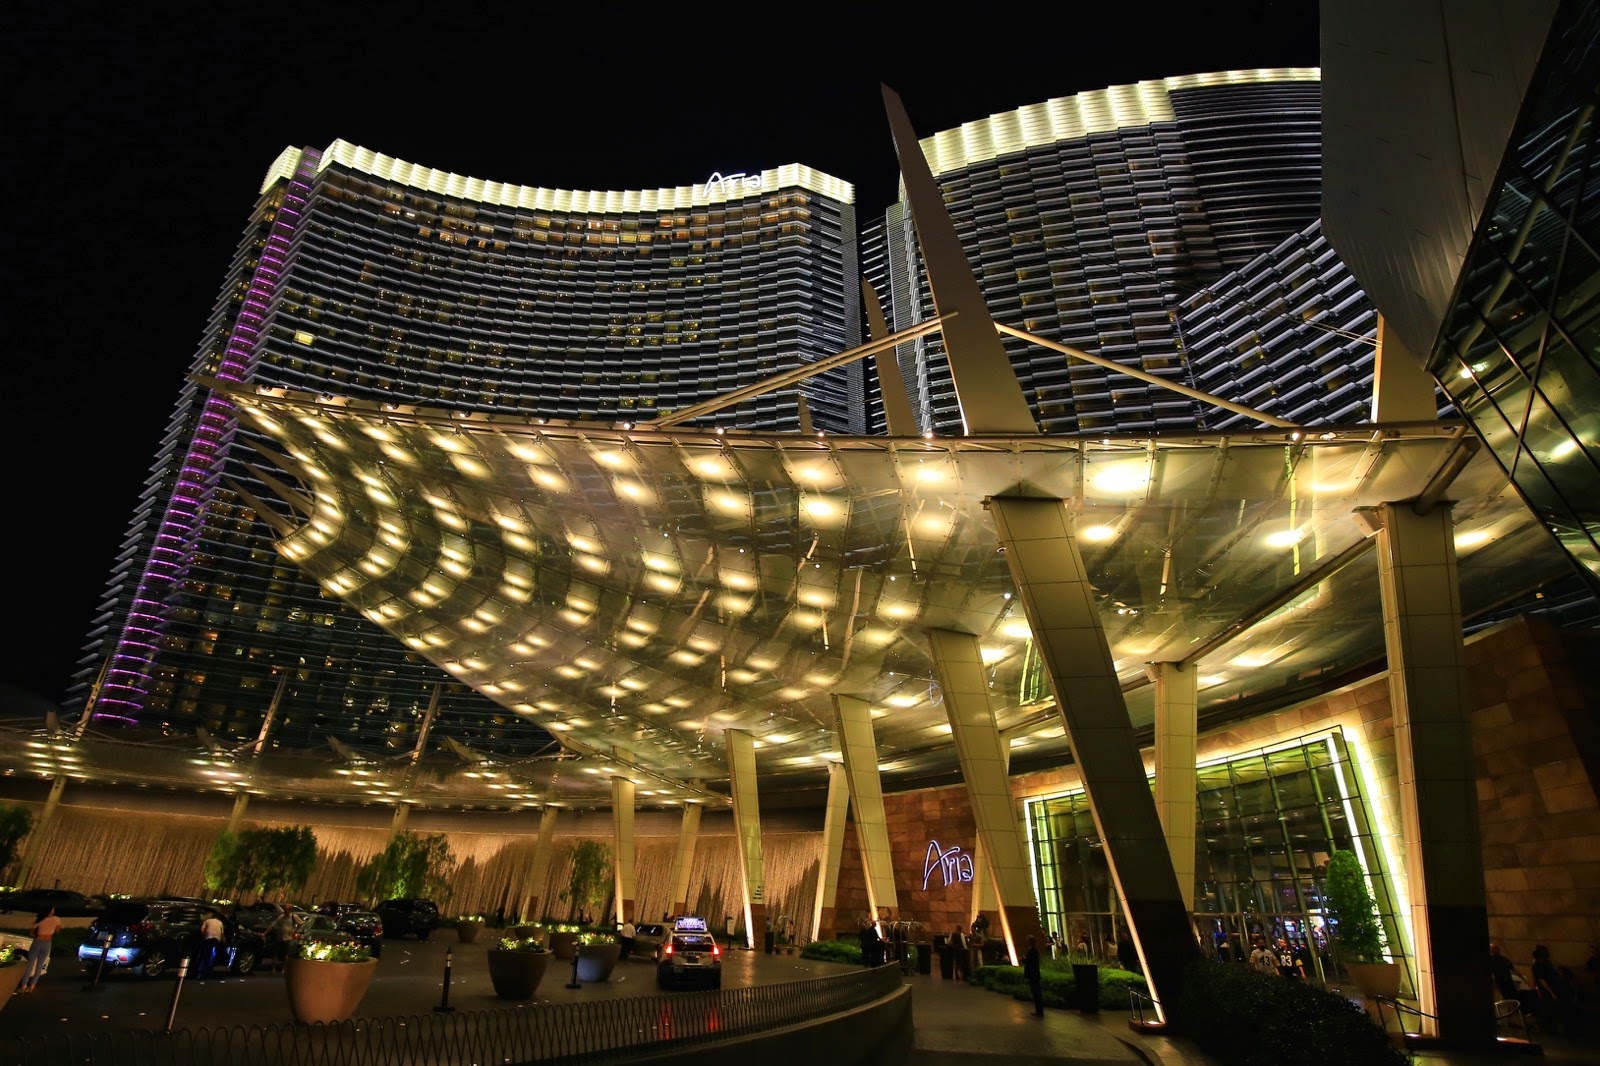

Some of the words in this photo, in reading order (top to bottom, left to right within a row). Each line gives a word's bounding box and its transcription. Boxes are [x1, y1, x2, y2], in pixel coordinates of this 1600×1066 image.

[922, 839, 975, 891] Aria
[1260, 955, 1271, 967] 43
[1280, 954, 1293, 967] 83
